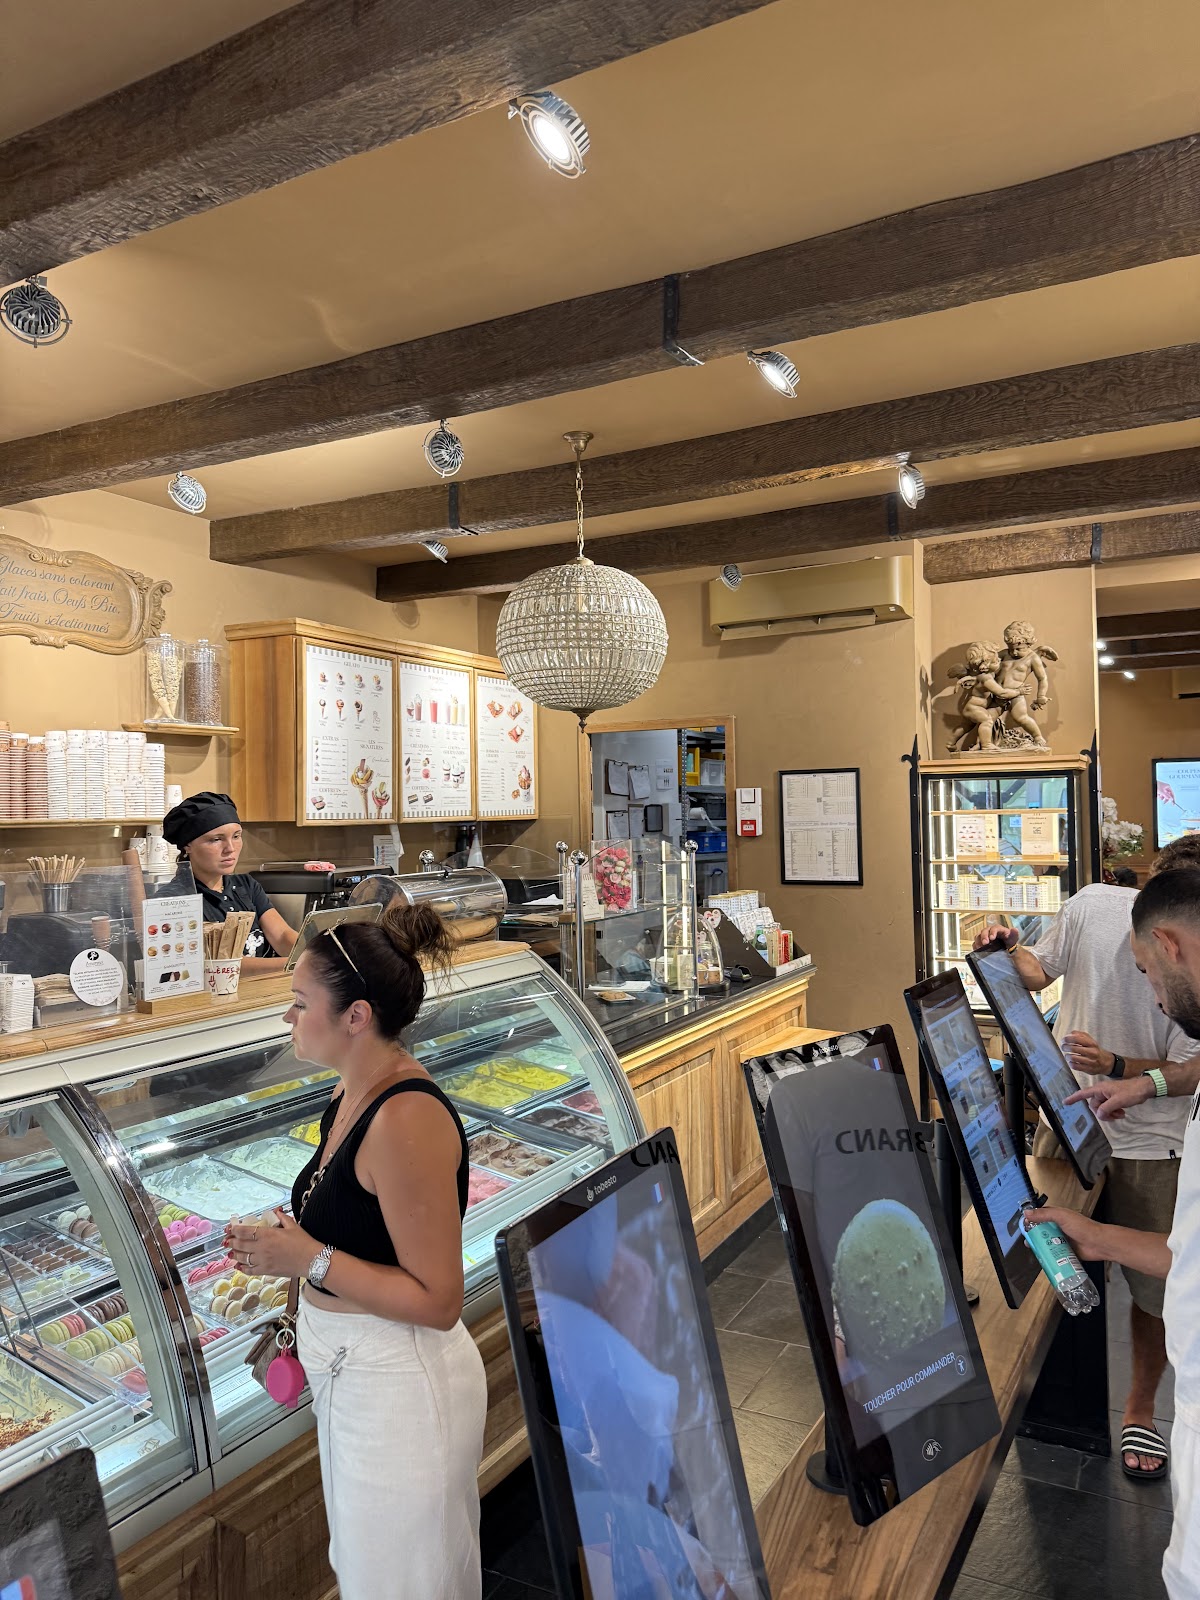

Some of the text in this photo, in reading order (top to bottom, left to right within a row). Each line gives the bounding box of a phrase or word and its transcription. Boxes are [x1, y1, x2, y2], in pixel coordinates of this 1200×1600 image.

[40, 570, 66, 583] sans
[69, 574, 115, 591] colorant
[53, 588, 87, 612] Oeufs
[0, 602, 110, 634] Fruits sélectionnés
[593, 1175, 617, 1195] tobesto
[863, 1351, 956, 1414] TOUCHER POUR COMMANDER
